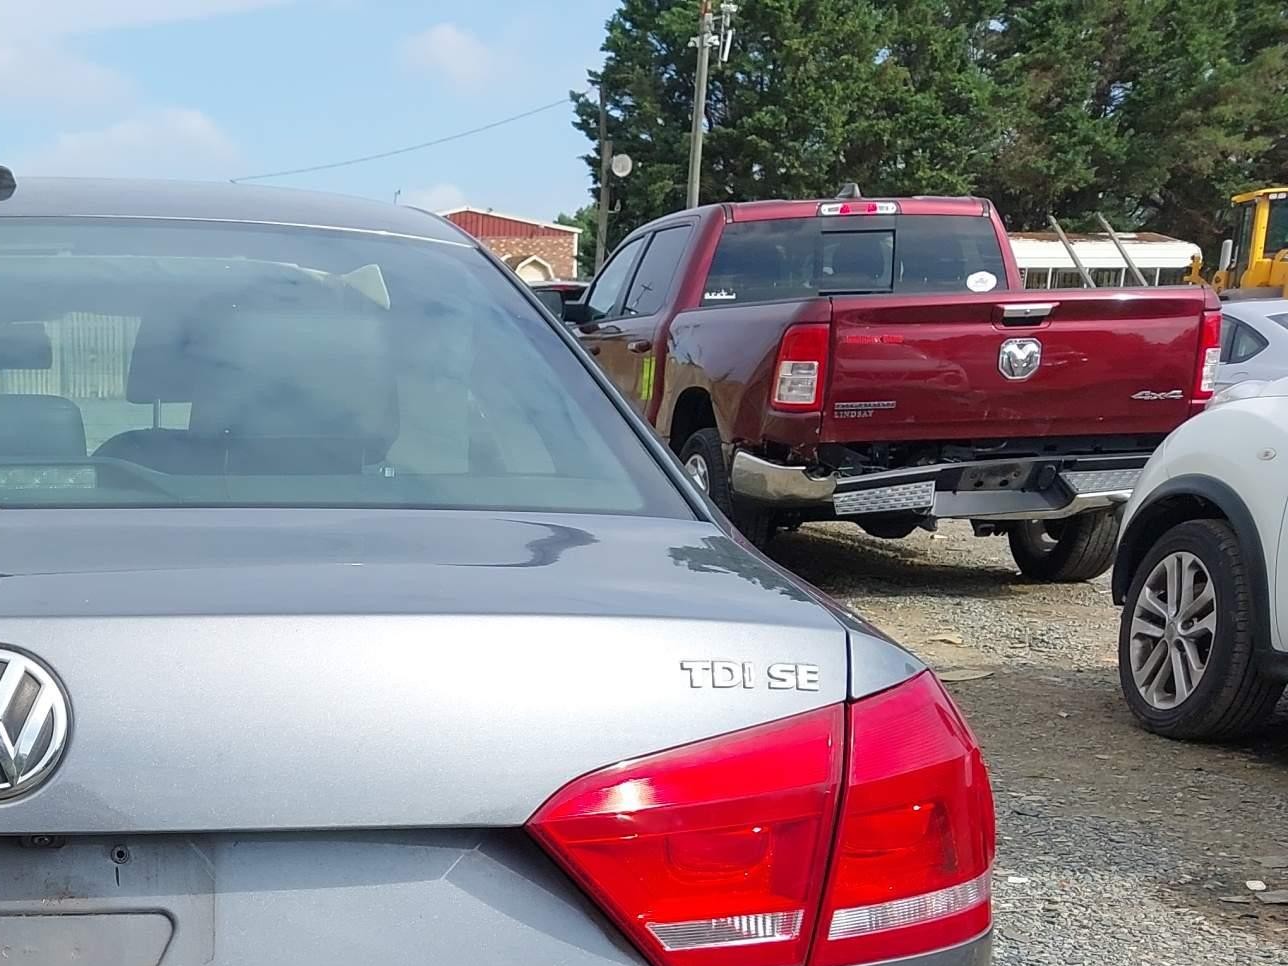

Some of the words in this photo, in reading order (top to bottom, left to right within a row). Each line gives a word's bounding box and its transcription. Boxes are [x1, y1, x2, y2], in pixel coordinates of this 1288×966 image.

[834, 410, 874, 419] LINDSAY
[680, 660, 755, 689] TDI
[767, 662, 820, 692] SE
